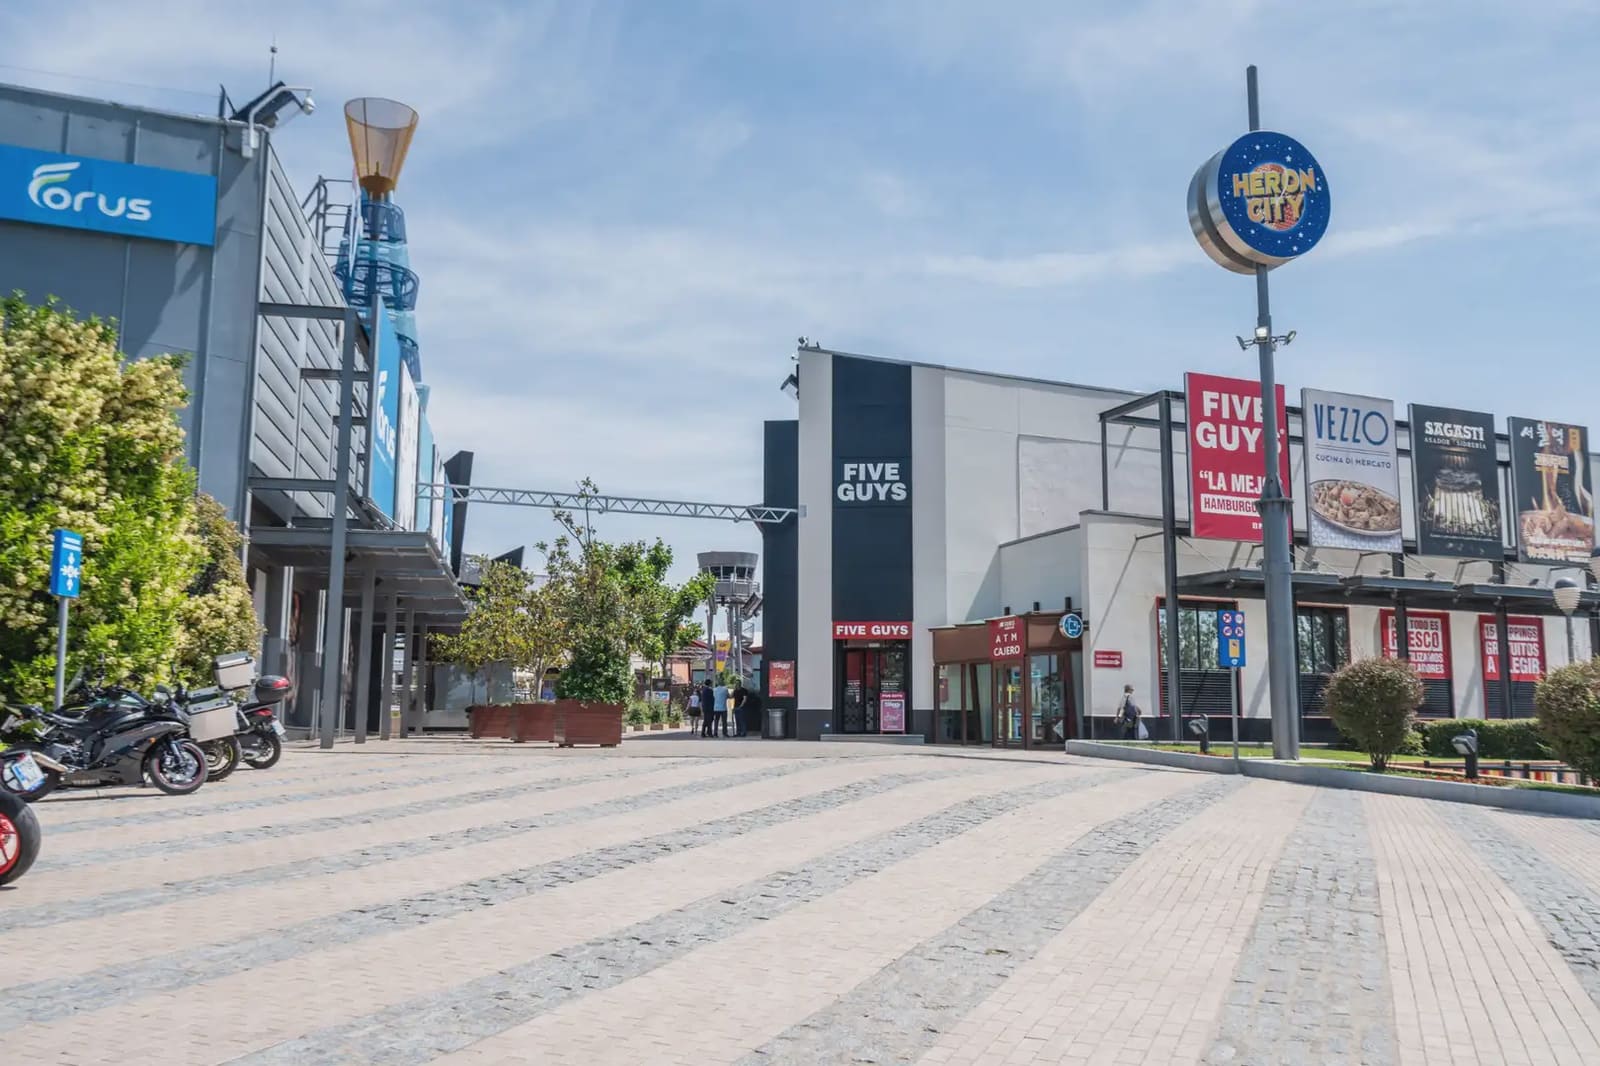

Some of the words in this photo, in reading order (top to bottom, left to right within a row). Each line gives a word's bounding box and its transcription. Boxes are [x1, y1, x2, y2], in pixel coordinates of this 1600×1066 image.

[1232, 168, 1316, 198] HERON
[1247, 192, 1304, 224] CITY
[1314, 403, 1390, 446] VEZZO
[1424, 421, 1485, 441] SAGASTI
[1315, 453, 1343, 464] CUCINA
[1345, 456, 1354, 465] DI
[1355, 458, 1392, 469] MERCATO
[843, 463, 900, 481] FIVE
[837, 482, 907, 502] GUYS
[836, 625, 866, 636] FIVE
[871, 625, 909, 636] GUYS
[1485, 625, 1495, 636] 15
[993, 645, 1021, 657] CAJERO
[1487, 656, 1497, 673] A
